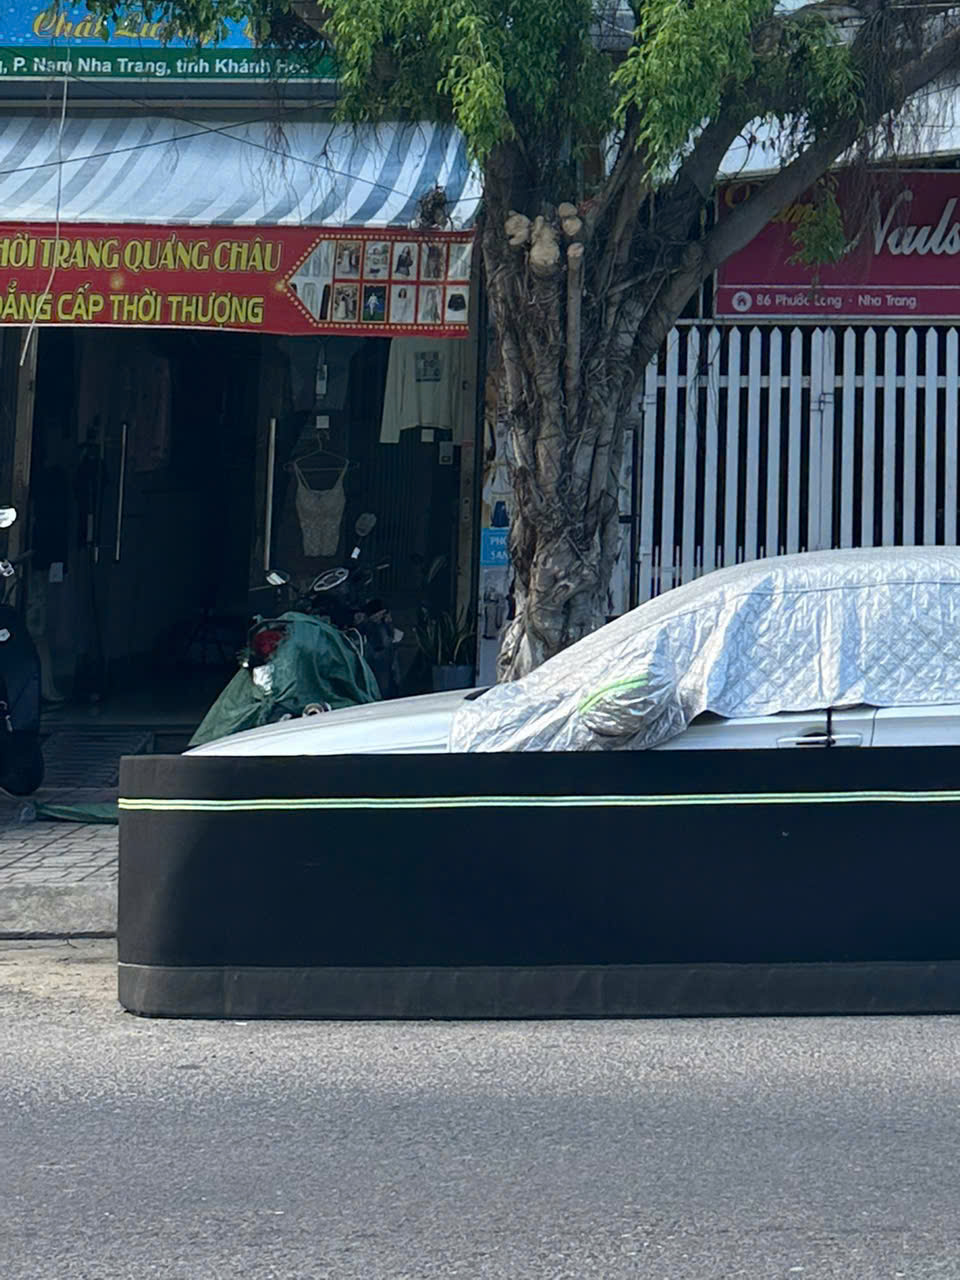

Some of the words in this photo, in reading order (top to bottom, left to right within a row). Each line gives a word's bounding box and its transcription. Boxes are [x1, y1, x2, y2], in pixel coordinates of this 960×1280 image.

[14, 57, 27, 72] P.
[33, 57, 72, 72] Nam
[78, 57, 112, 72] Nha
[117, 58, 171, 76] Trang,
[215, 58, 271, 73] Khánh
[40, 238, 119, 269] TRANG
[214, 235, 282, 272] CHÂU
[0, 279, 53, 321] ẲNG
[57, 282, 104, 321] CẤP
[110, 287, 162, 321] THỜI
[168, 292, 264, 327] THƯỢNG
[756, 294, 771, 306] 86
[858, 295, 882, 307] Nha
[886, 295, 917, 310] Trang
